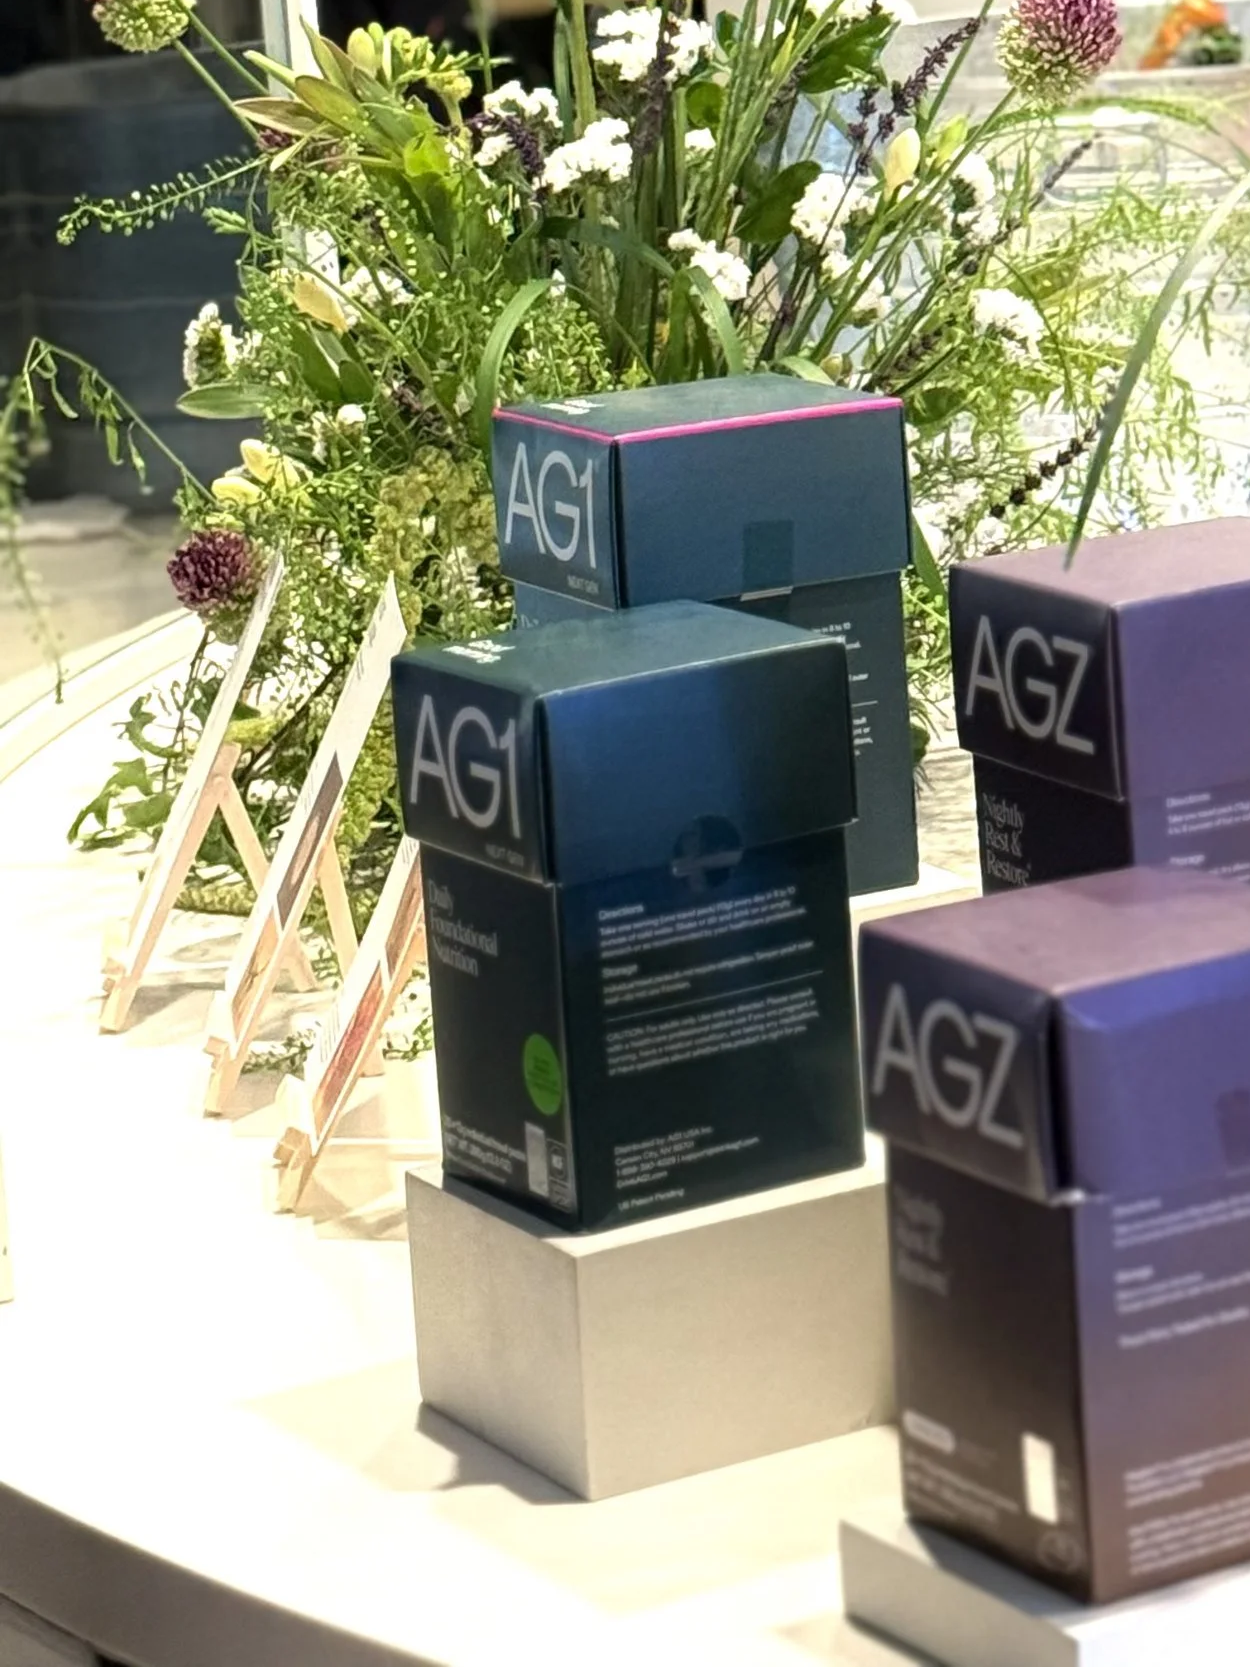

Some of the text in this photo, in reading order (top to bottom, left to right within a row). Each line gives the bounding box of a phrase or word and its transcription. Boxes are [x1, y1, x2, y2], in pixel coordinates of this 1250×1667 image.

[505, 442, 597, 569] AG1
[965, 614, 1095, 755] AGZ
[410, 694, 521, 839] AG1
[428, 877, 454, 917] Daily
[430, 907, 498, 957] Foundational
[598, 902, 645, 921] Directions
[432, 934, 479, 977] Nutrition
[873, 982, 1024, 1149] AGZ
